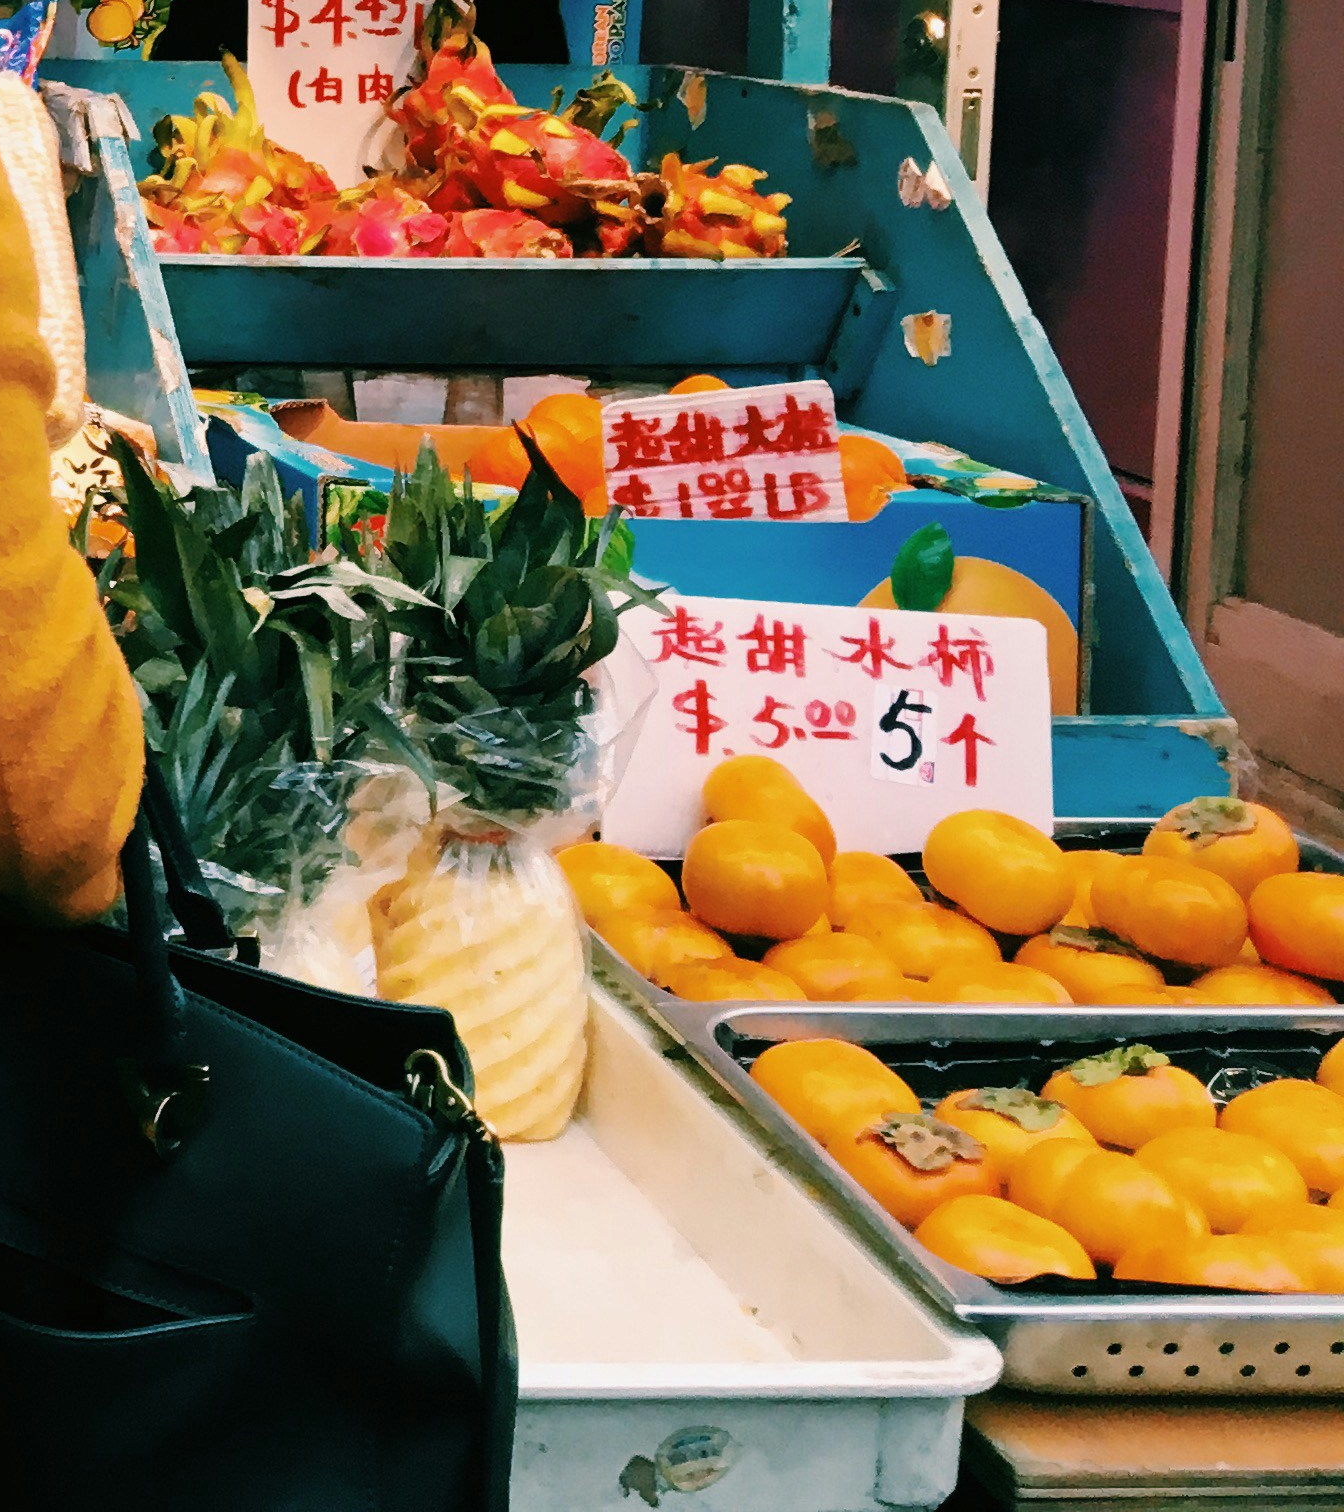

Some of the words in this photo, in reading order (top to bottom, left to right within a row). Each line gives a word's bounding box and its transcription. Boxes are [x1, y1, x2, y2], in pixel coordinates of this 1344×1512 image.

[764, 471, 830, 520] LB
[648, 604, 997, 702] 超甜水柿
